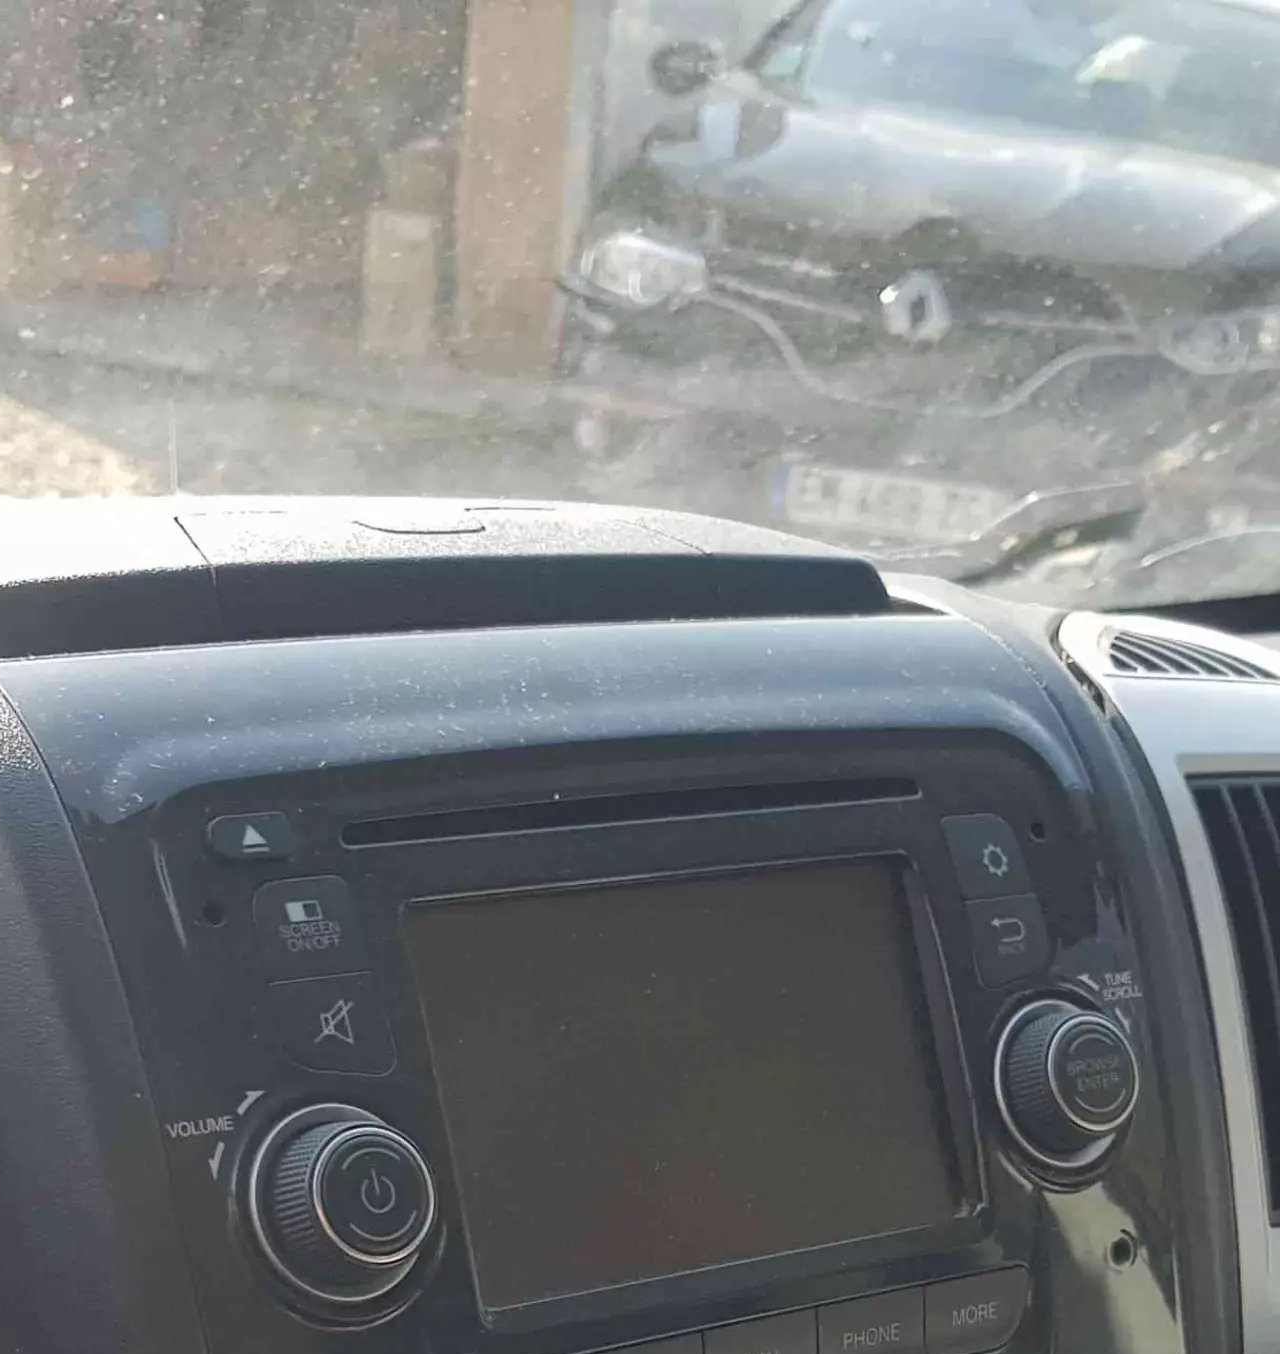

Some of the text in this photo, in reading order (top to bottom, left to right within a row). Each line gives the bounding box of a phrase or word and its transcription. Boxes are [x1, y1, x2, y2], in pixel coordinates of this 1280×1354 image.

[278, 920, 341, 938] SCREEN
[1104, 970, 1132, 987] TUNE
[1102, 985, 1143, 1001] SCROLL
[165, 1114, 235, 1139] VOLUME
[951, 1301, 999, 1328] MORE
[842, 1320, 901, 1350] PHONE
